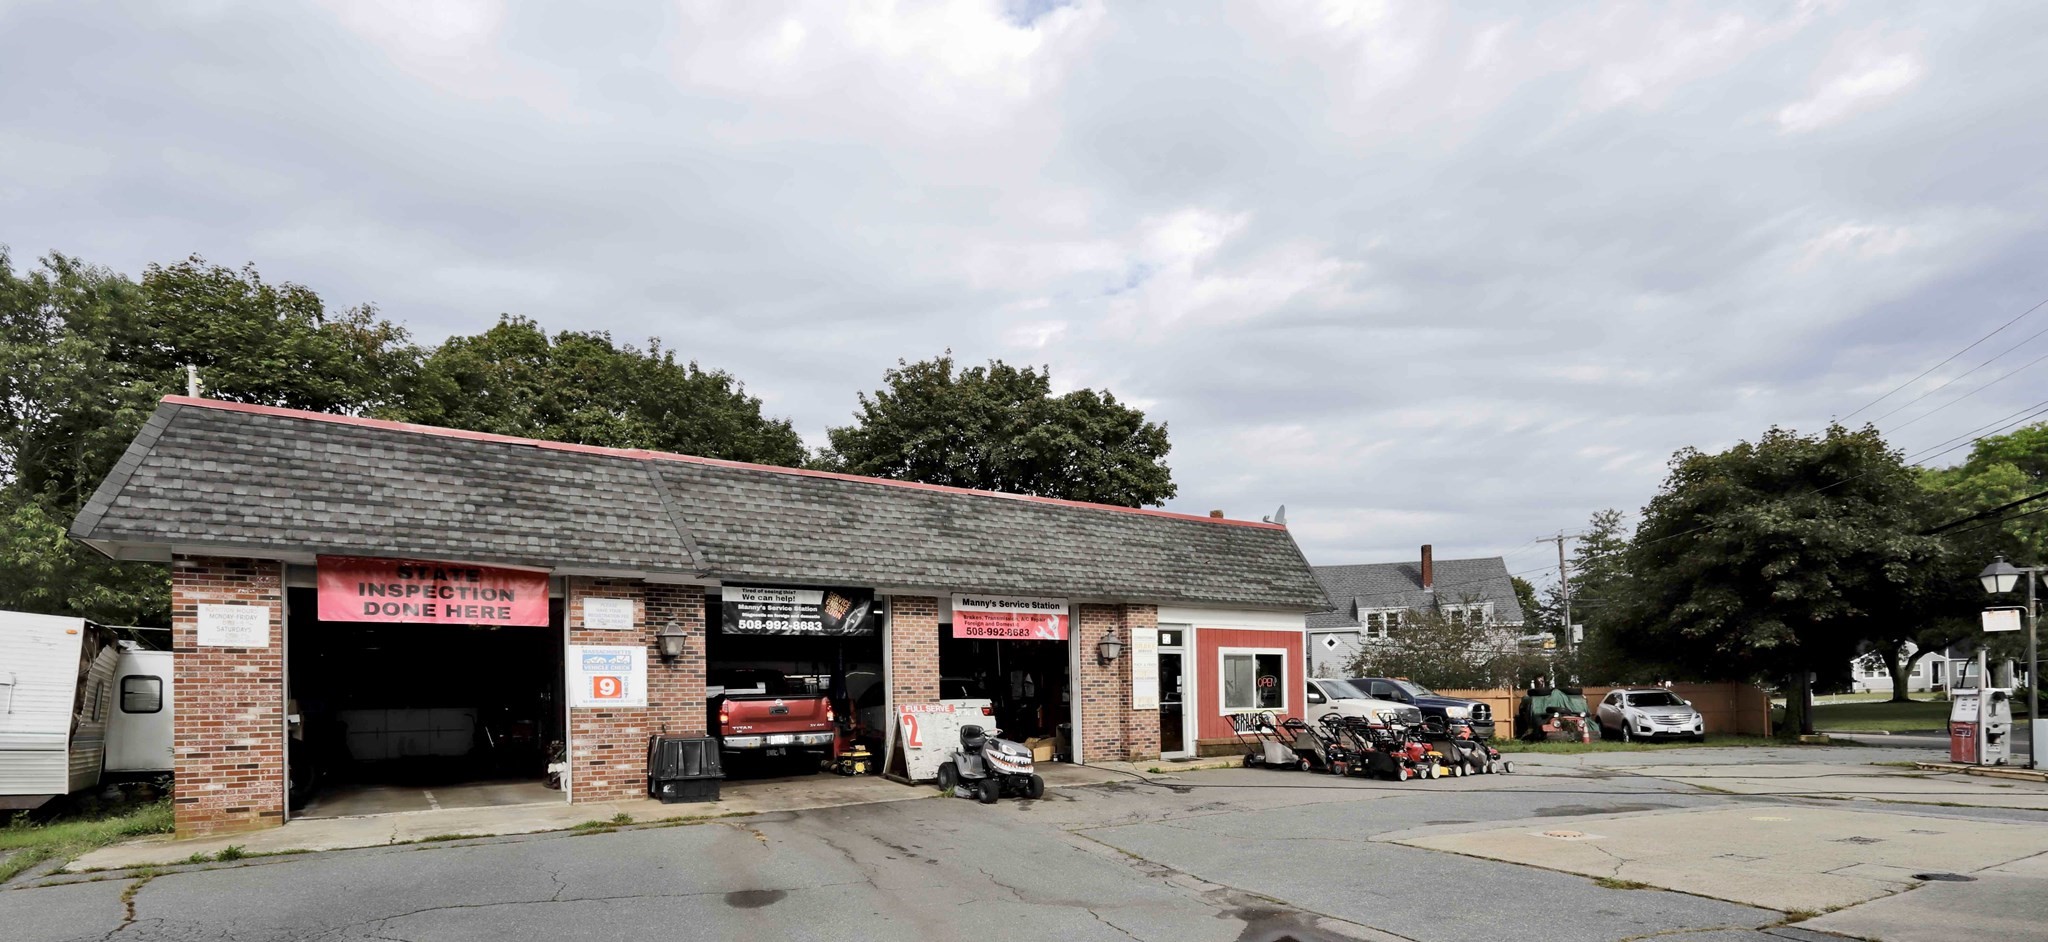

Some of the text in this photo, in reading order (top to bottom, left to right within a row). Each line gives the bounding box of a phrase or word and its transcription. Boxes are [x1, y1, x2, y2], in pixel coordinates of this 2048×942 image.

[397, 565, 480, 582] STATE
[358, 582, 515, 602] INSPECTION
[775, 595, 796, 603] help!
[363, 602, 511, 620] DONE HERE
[737, 603, 766, 611] Manny's
[826, 598, 848, 615] ENGINE
[962, 598, 1060, 610] Manny's Service Station
[825, 605, 843, 620] SOON
[738, 619, 823, 631] 508-992-8683
[966, 627, 1030, 637] 508-992-8683
[600, 678, 616, 696] 9
[926, 705, 950, 713] SERVE
[1235, 712, 1264, 732] BRAKE
[902, 714, 923, 747] 2
